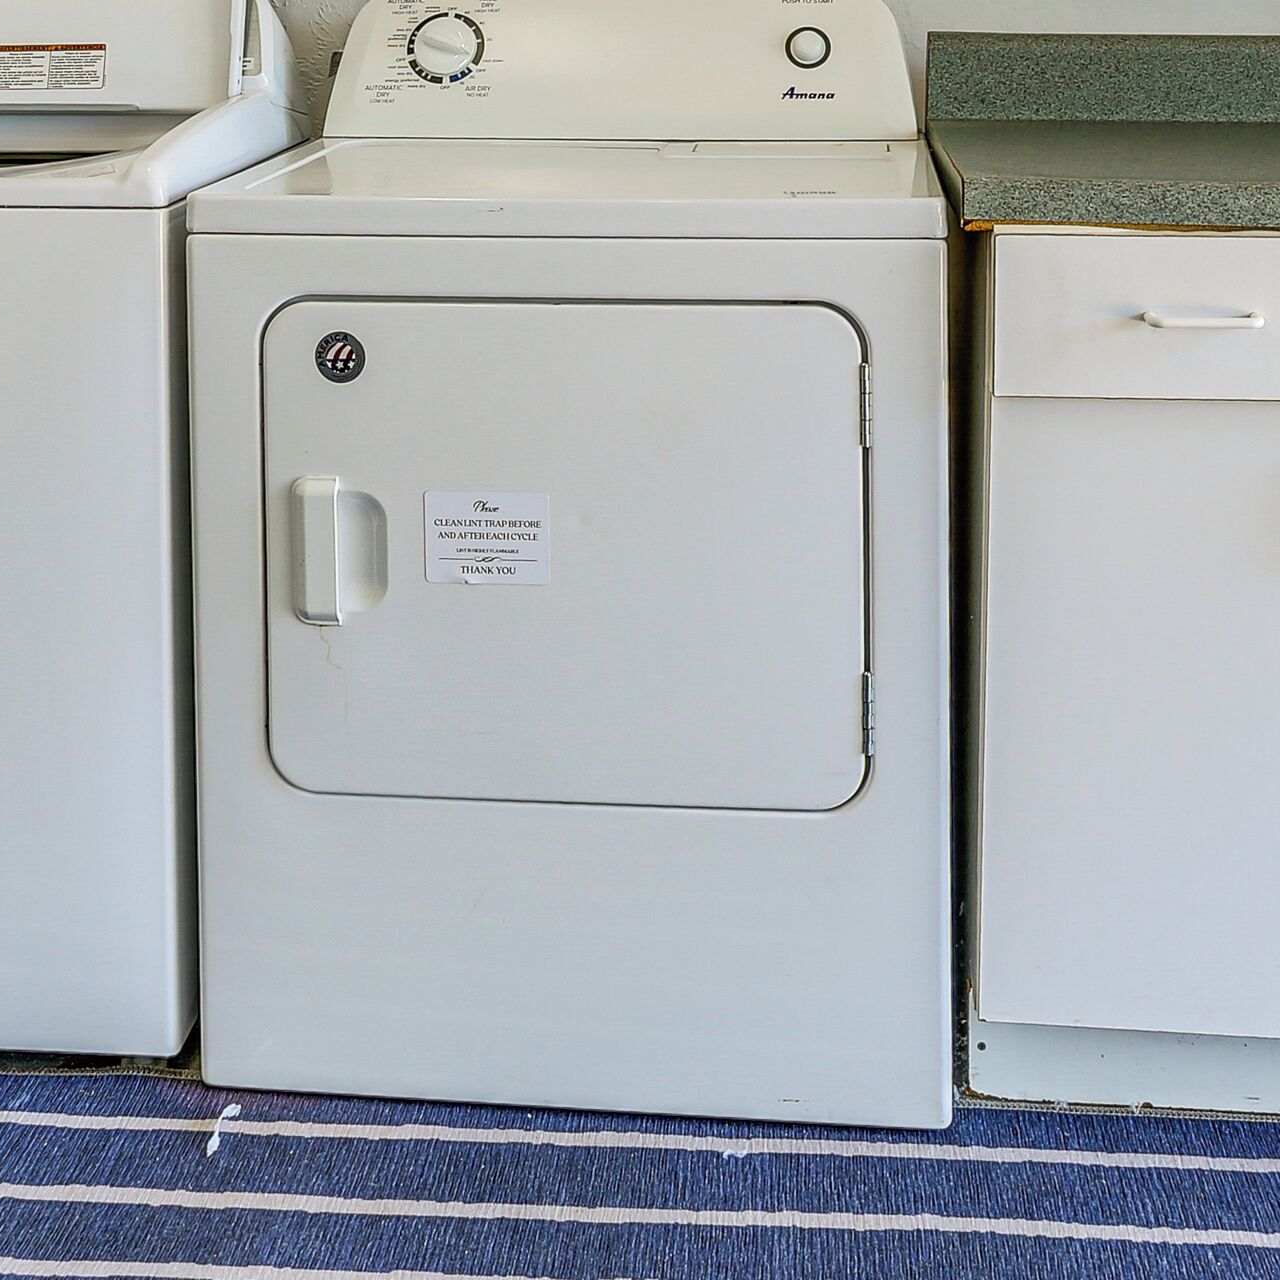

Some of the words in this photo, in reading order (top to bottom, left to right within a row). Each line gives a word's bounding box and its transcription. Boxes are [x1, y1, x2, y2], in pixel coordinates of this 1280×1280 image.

[781, 86, 835, 100] Amana
[318, 334, 349, 367] AMERICA
[434, 518, 464, 527] CLEAN
[464, 519, 483, 527] LINT
[484, 520, 507, 528] TRAP
[508, 520, 541, 529] BEFORE
[437, 531, 458, 539] AND
[459, 532, 486, 540] AFTER
[486, 532, 510, 541] EACH
[510, 533, 539, 541] CYCLE
[460, 565, 494, 575] THANK
[495, 566, 517, 575] YOU
